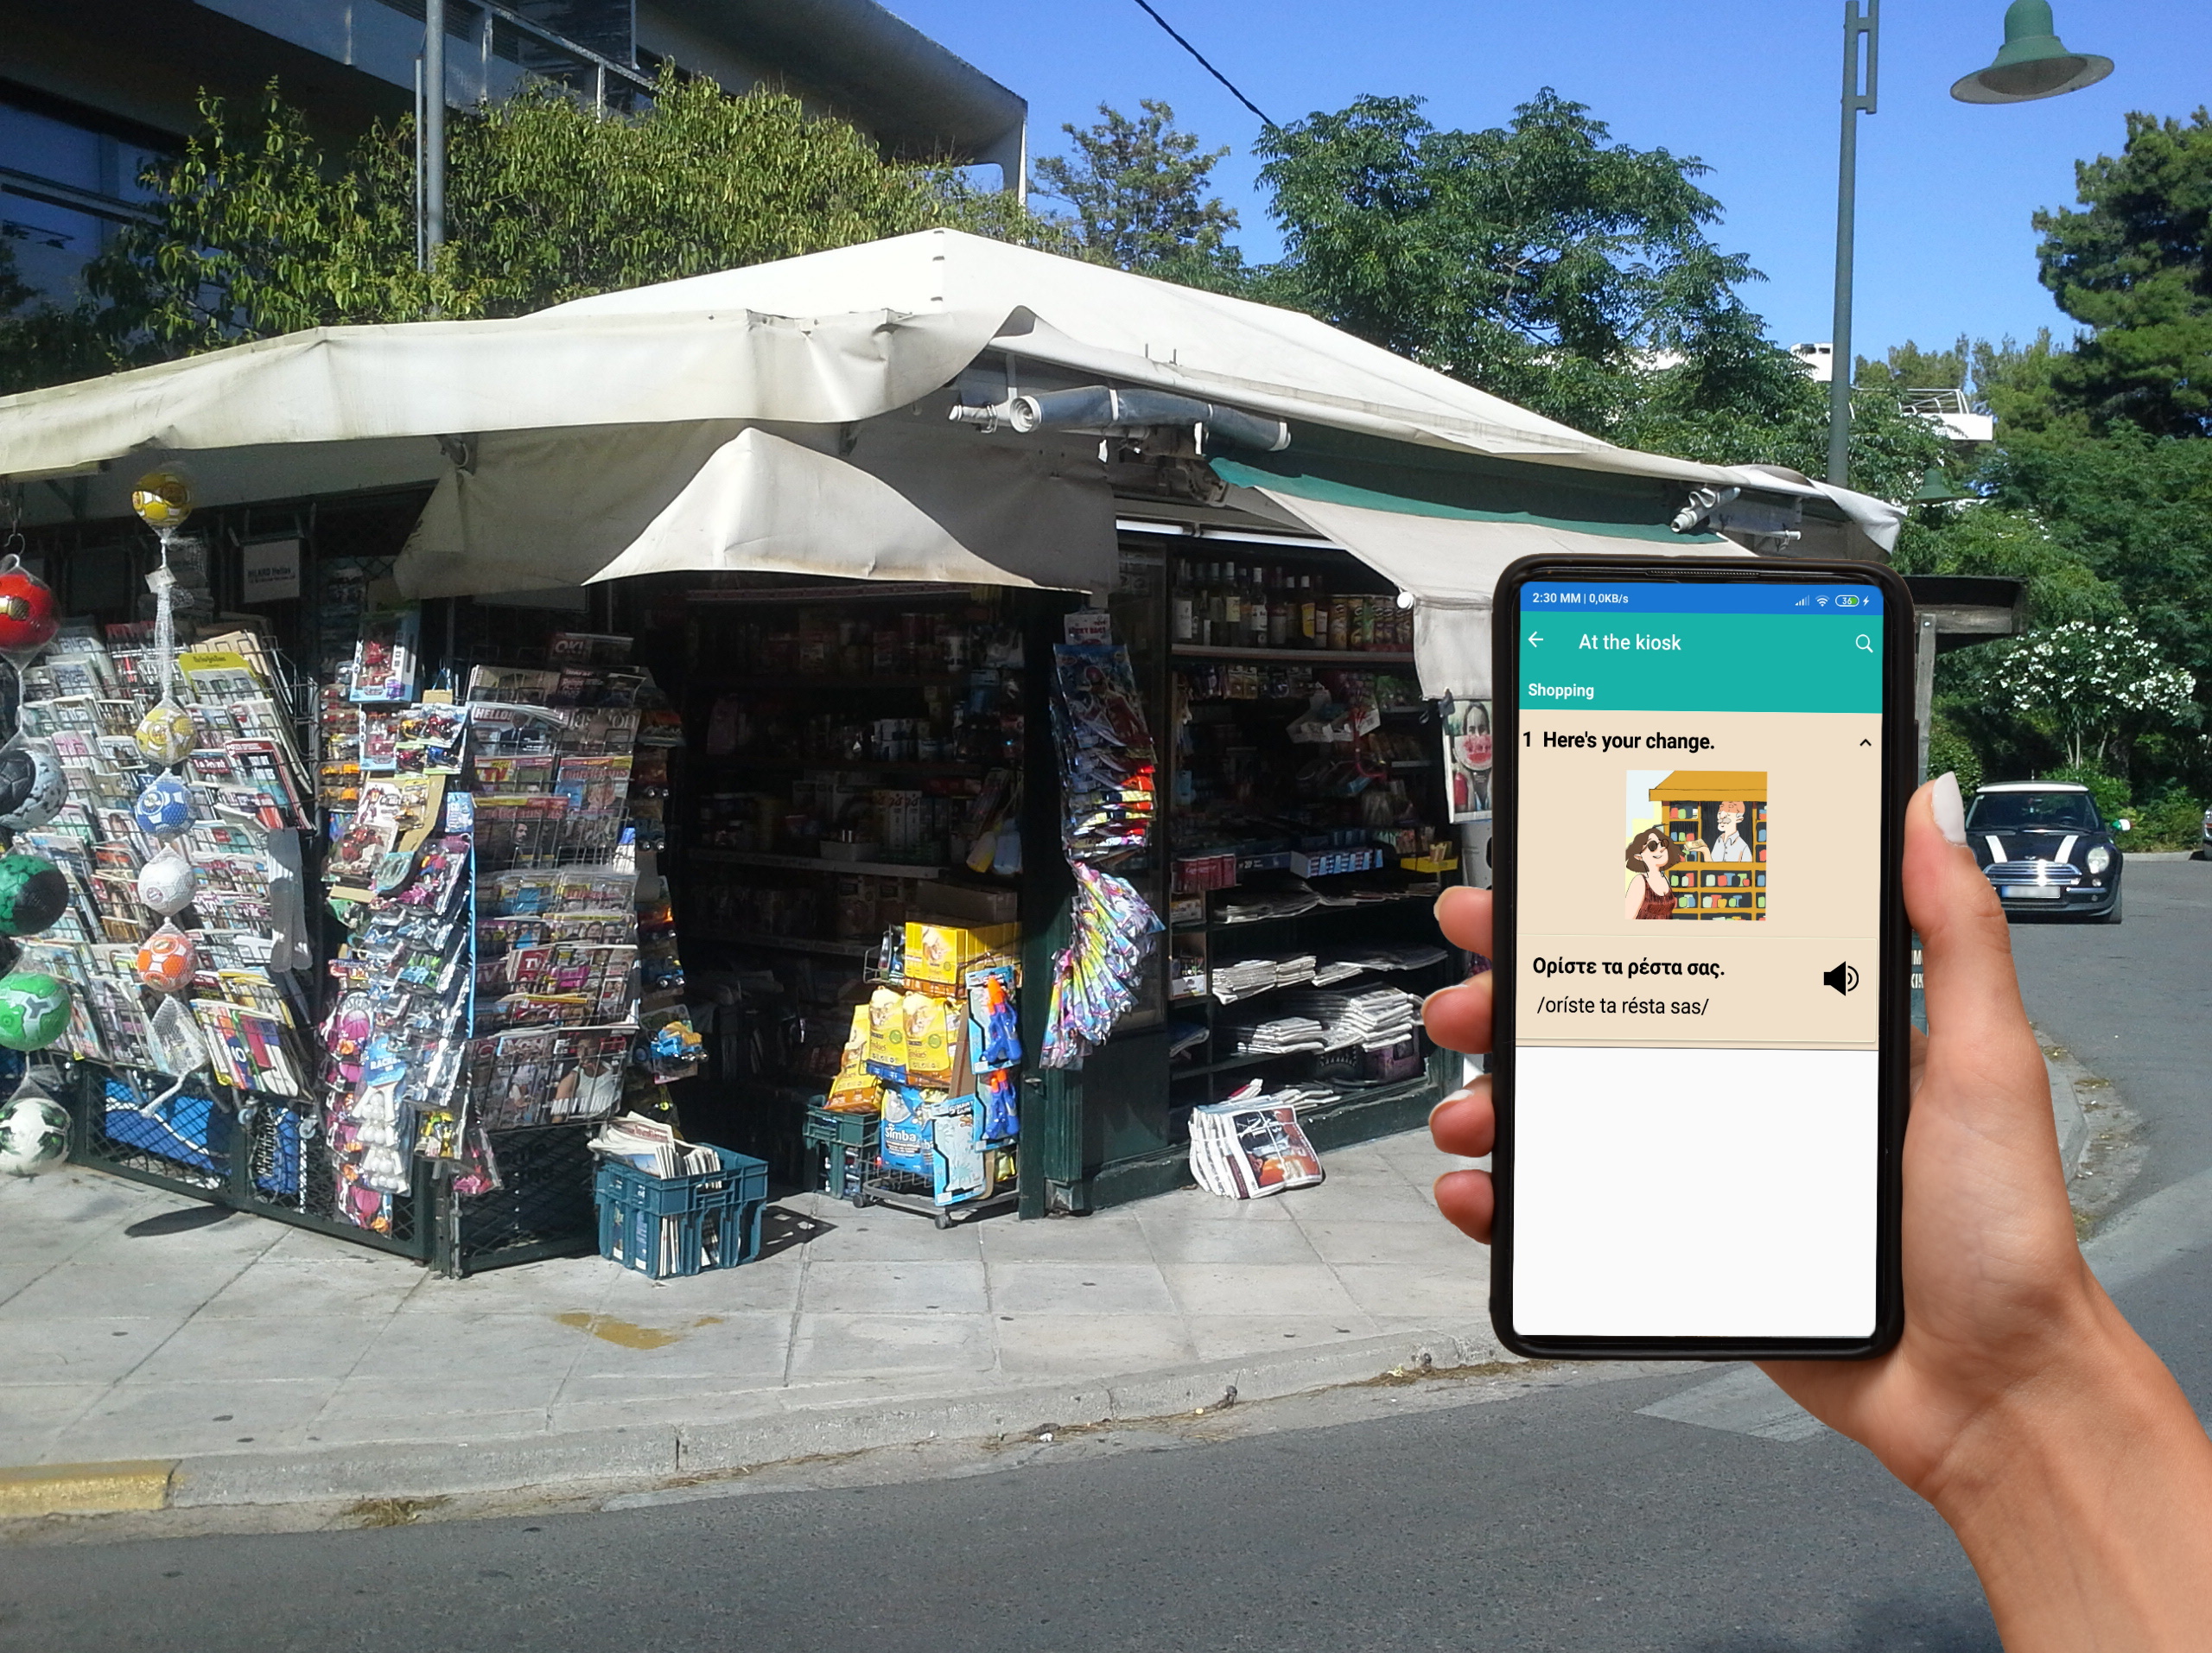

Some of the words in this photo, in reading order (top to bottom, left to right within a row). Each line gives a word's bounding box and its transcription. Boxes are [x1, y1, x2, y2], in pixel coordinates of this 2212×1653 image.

[1532, 592, 1557, 603] 2:30
[1588, 593, 1629, 605] 0,0KB/s
[1842, 597, 1853, 606] 36
[1579, 633, 1599, 651] At
[1602, 633, 1630, 651] the
[1636, 633, 1681, 651] kiosk
[1528, 683, 1595, 700] Shopping
[475, 708, 513, 721] HELLO!
[1522, 731, 1532, 747] 1
[1543, 731, 1597, 749] Here's
[1601, 736, 1642, 753] your
[1645, 731, 1715, 753] change.
[1533, 956, 1597, 978] Ορίστε
[1601, 962, 1624, 976] τα
[1628, 957, 1683, 979] ρέστα
[1687, 963, 1726, 979] σας.
[1536, 995, 1595, 1014] /oríste
[1599, 998, 1617, 1014] ta
[1622, 996, 1666, 1015] résta
[1670, 997, 1710, 1017] sas/
